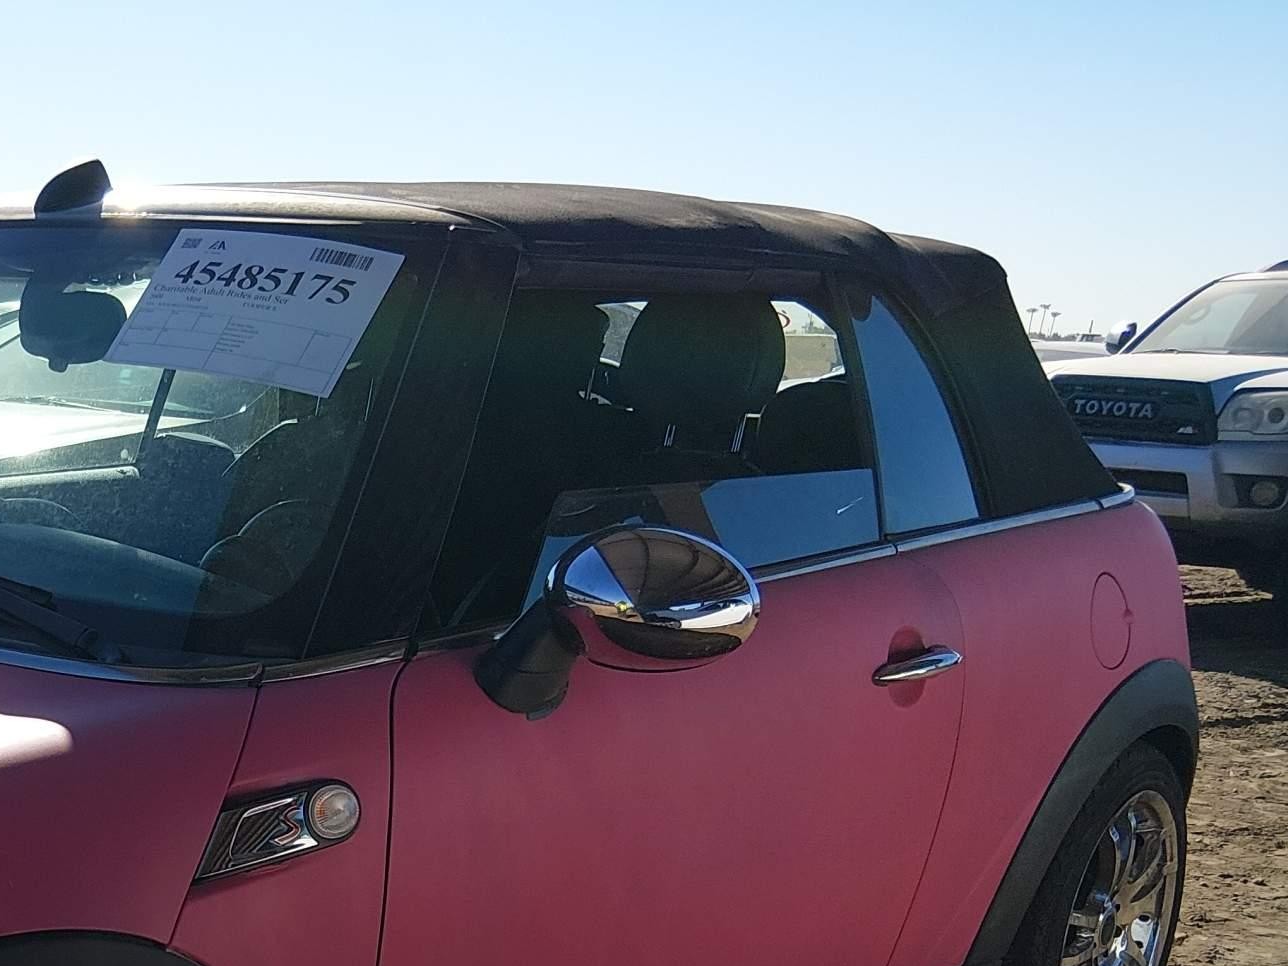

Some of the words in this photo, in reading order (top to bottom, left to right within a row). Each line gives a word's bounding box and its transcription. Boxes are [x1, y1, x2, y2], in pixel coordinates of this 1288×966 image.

[174, 260, 357, 304] 45485175
[153, 284, 198, 295] Charitable
[200, 287, 226, 298] Adult
[226, 289, 251, 300] Rides
[253, 294, 273, 303] and
[1074, 399, 1153, 419] TOYOTA
